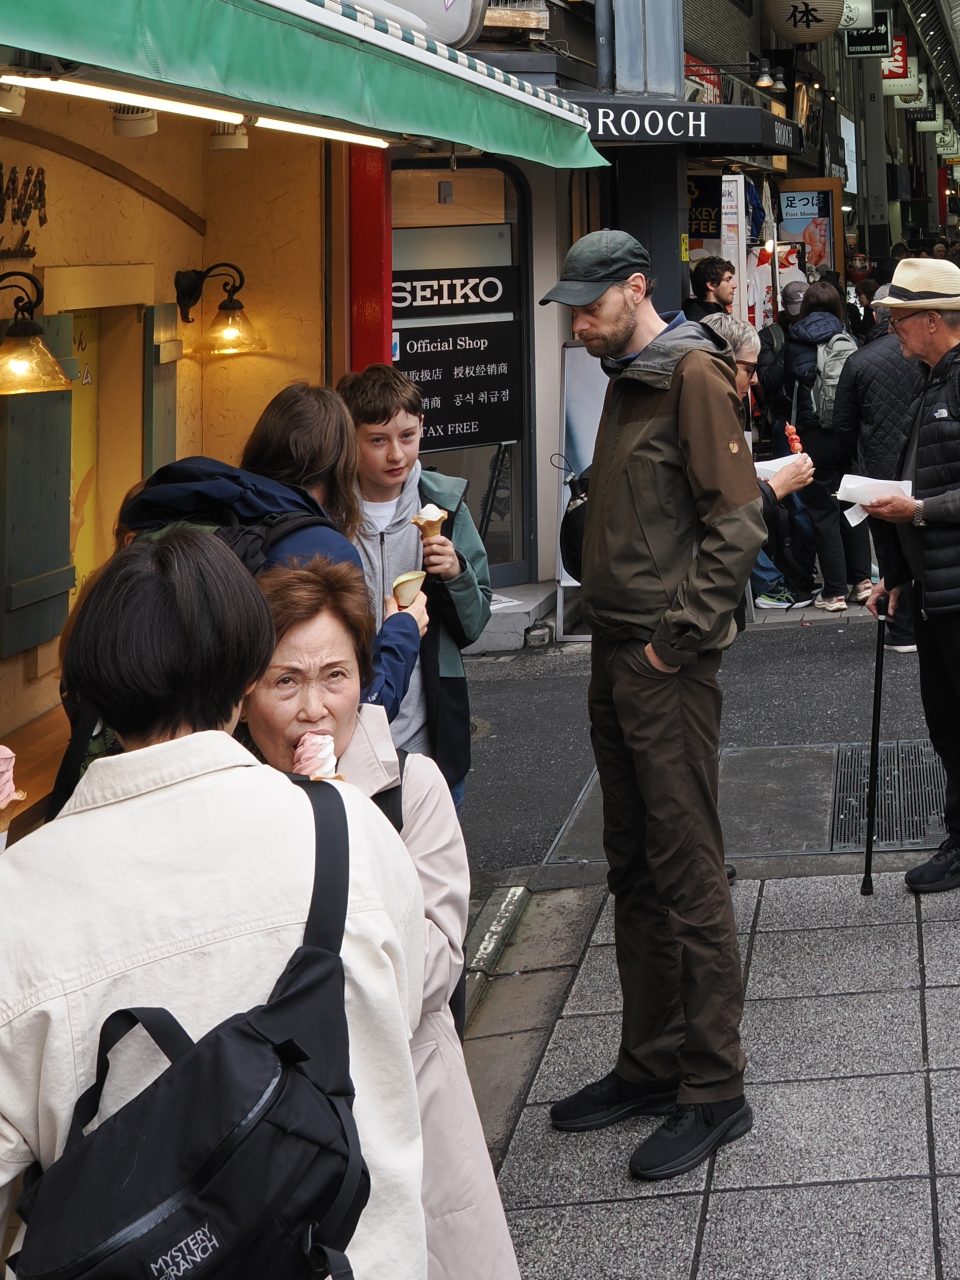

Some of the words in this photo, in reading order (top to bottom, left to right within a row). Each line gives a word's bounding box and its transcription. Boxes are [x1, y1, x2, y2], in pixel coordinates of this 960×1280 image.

[585, 108, 706, 137] ROOCH
[774, 121, 793, 148] BROOCH
[392, 277, 503, 308] SEIKO
[406, 337, 453, 353] Official
[457, 336, 488, 351] Shop
[453, 362, 508, 379] 授权经销商
[453, 393, 474, 407] 공식
[478, 389, 509, 404] 취급점
[420, 423, 445, 438] TAX
[448, 422, 479, 436] FREE
[150, 1222, 211, 1276] MYSTERY
[167, 1235, 219, 1280] RANCH
